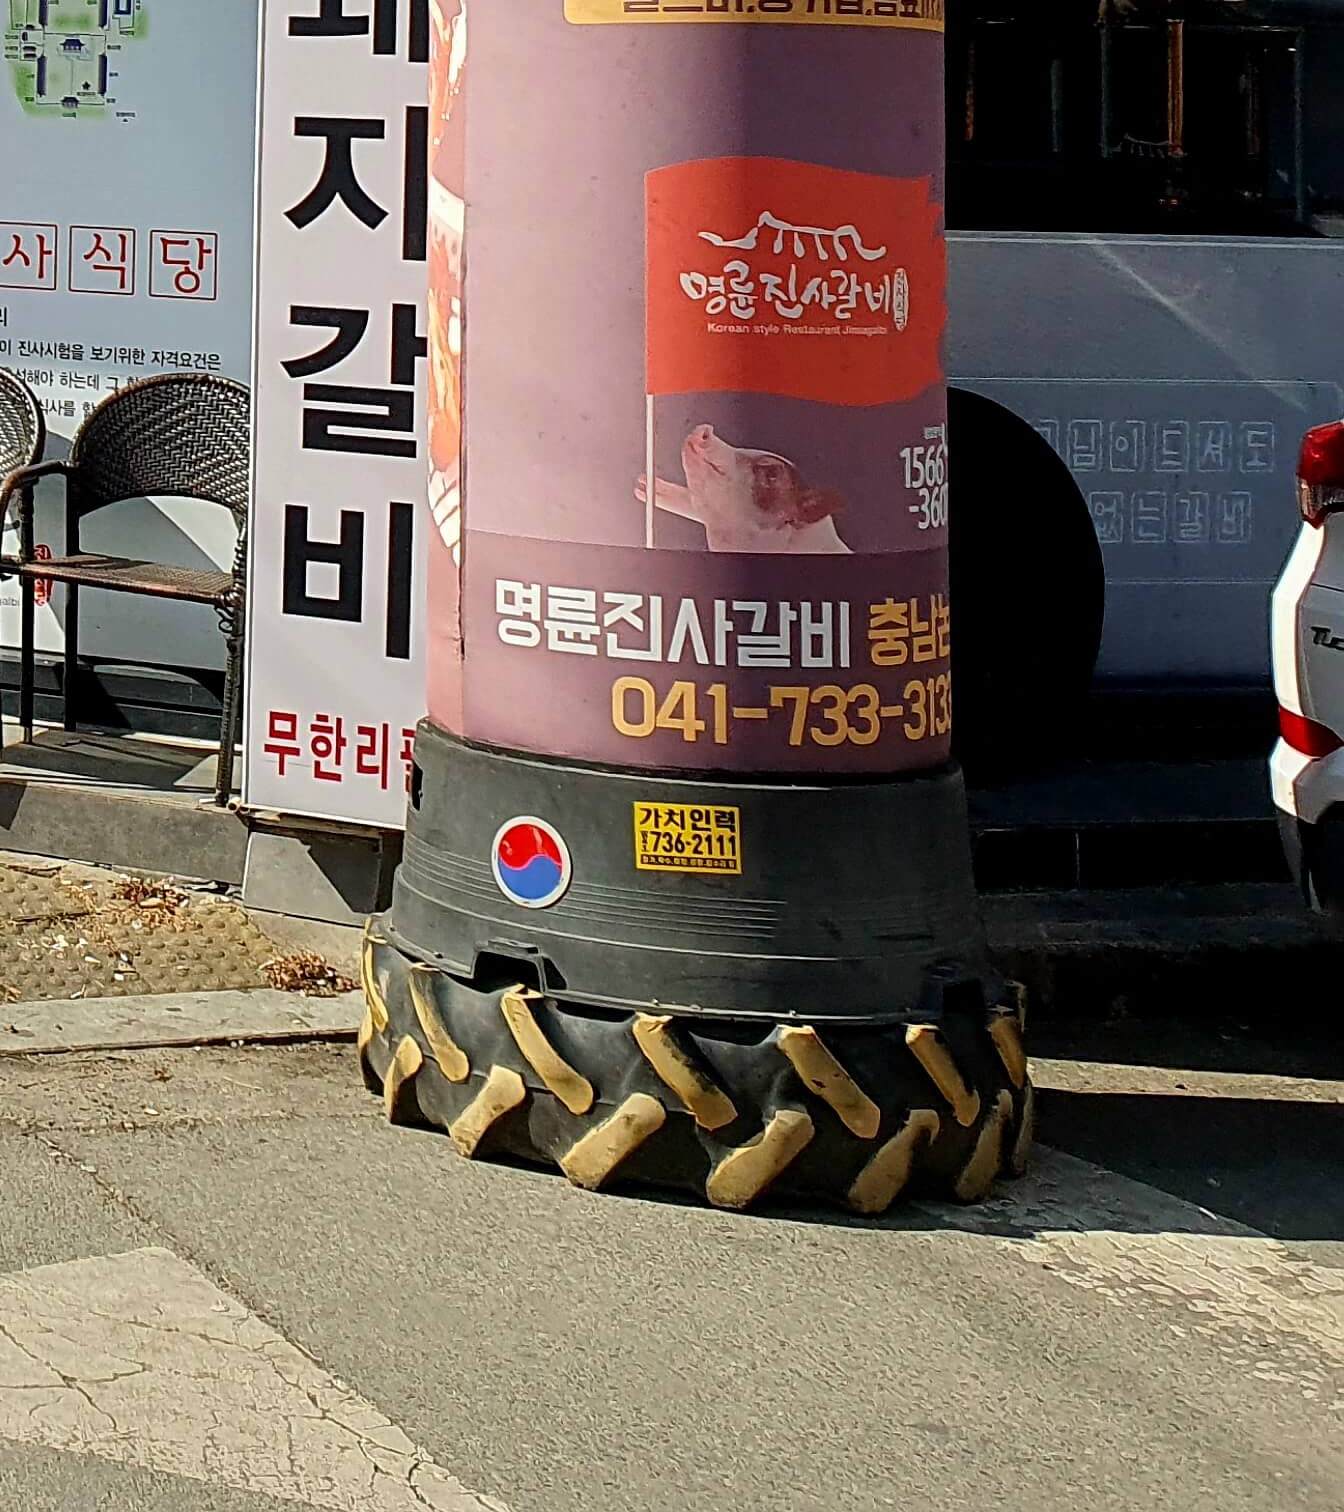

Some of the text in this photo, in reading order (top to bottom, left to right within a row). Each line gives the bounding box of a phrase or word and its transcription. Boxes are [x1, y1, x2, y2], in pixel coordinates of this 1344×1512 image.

[679, 260, 891, 320] 명륜진사갈비
[18, 339, 84, 361] 진사시험을
[90, 345, 145, 366] 보기위한
[151, 350, 221, 372] 자격요건은
[59, 371, 100, 390] 하는데
[900, 445, 946, 489] 1566
[495, 579, 850, 669] 명륜진사갈비
[612, 676, 952, 747] 041-733-313
[640, 807, 737, 834] 가치인력
[649, 830, 737, 857] 736-2111
